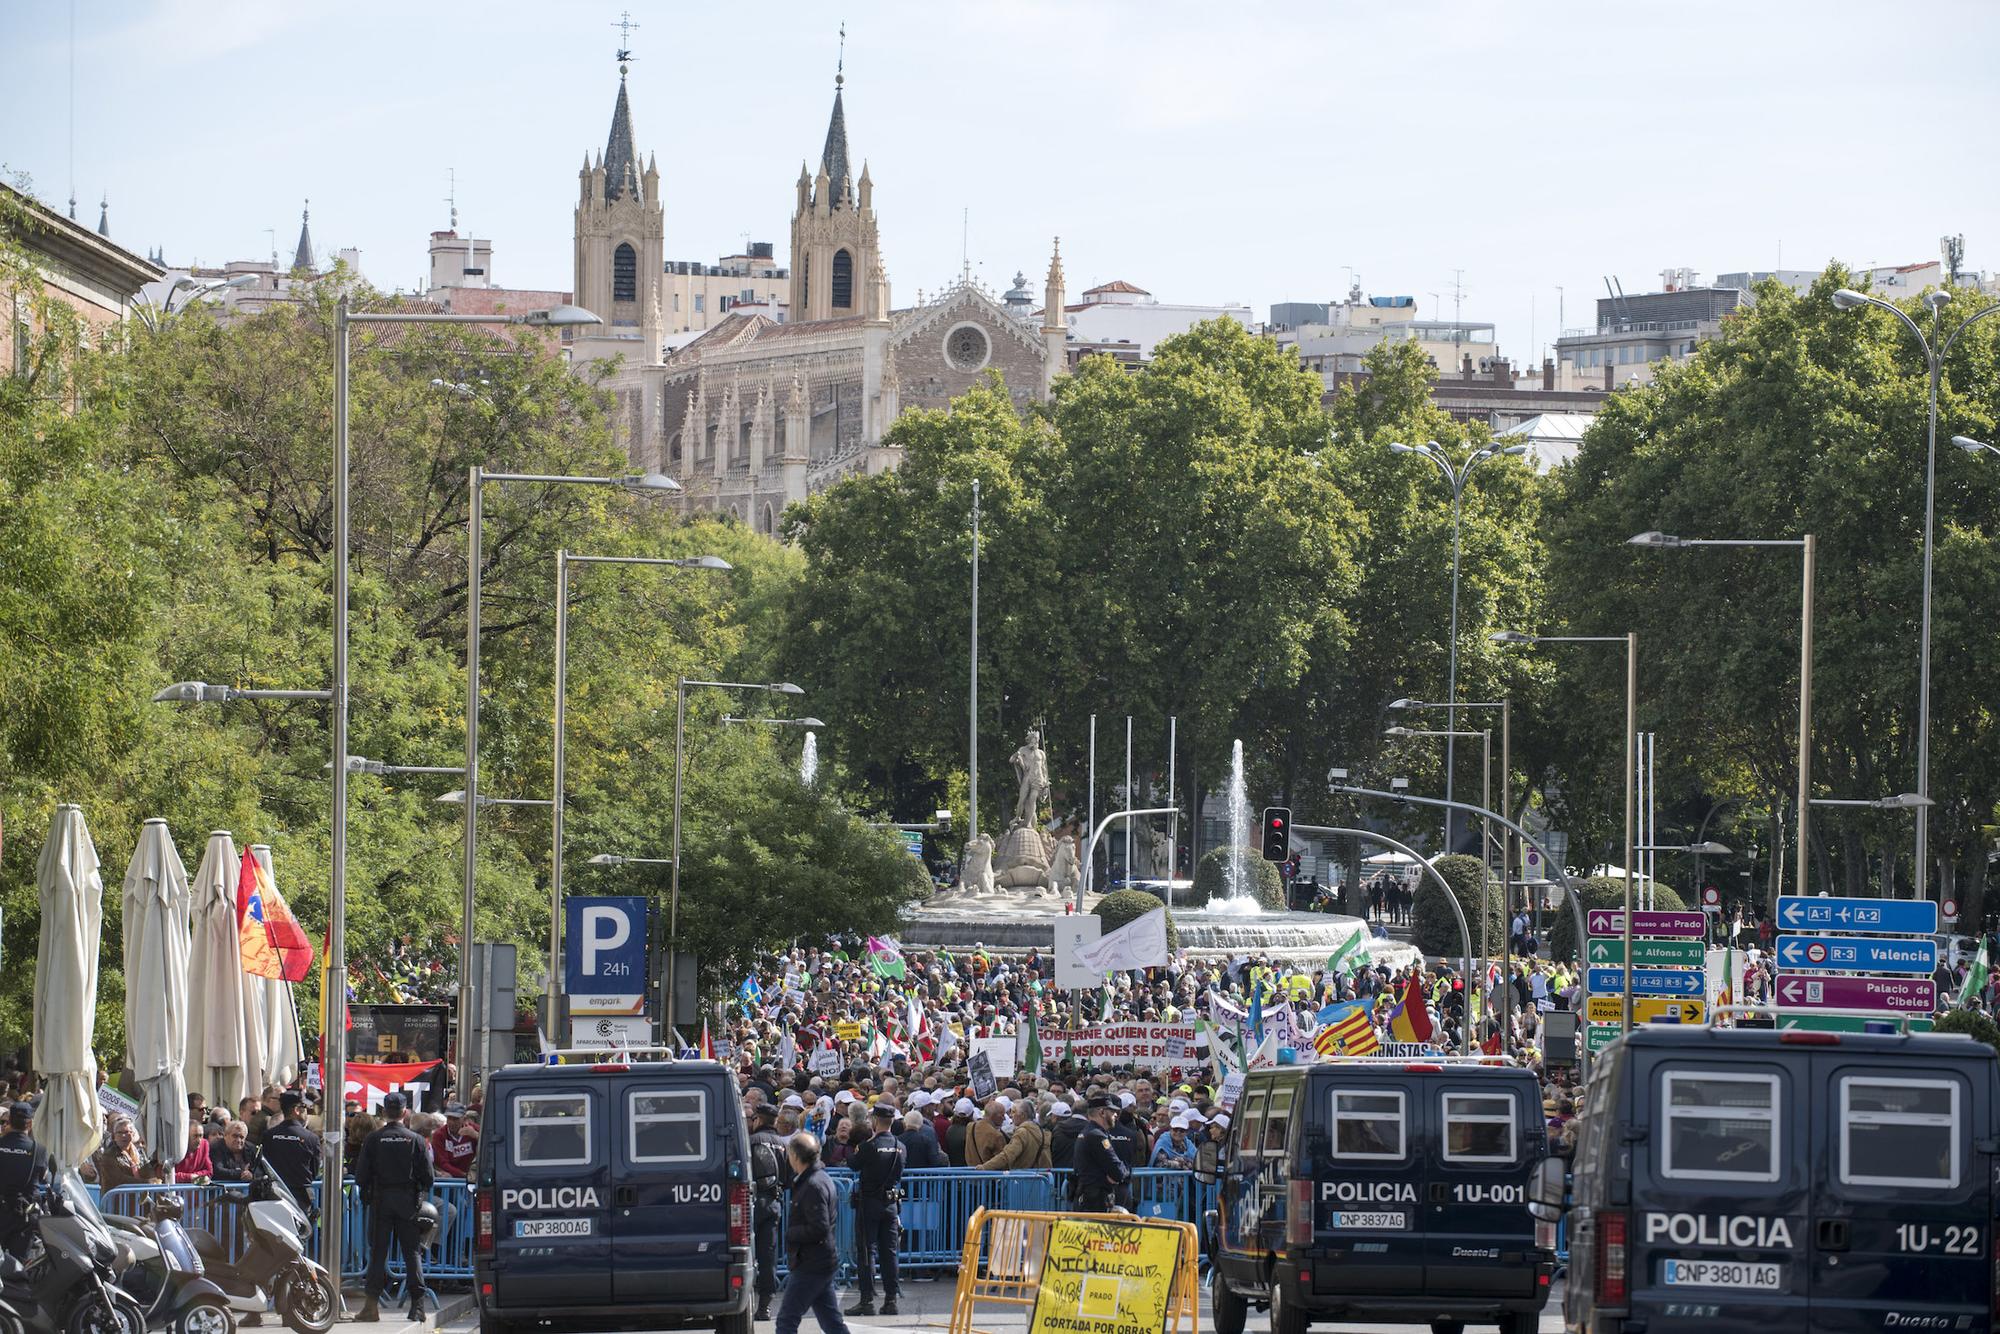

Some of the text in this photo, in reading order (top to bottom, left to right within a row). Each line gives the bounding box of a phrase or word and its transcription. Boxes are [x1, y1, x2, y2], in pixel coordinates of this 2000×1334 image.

[1811, 909, 1878, 921] A-1 A-2
[1674, 919, 1702, 929] Prado
[582, 905, 631, 976] P
[1646, 948, 1682, 957] Alfonso
[1688, 949, 1701, 958] XII
[1833, 948, 1931, 962] R-3 Valencia
[603, 963, 630, 976] 24h
[1602, 976, 1617, 984] A-3
[1642, 977, 1661, 986] A-42
[1666, 979, 1681, 987] R-5
[1867, 984, 1930, 995] Palacio de
[589, 998, 621, 1006] empark
[1886, 996, 1930, 1008] Cibeles
[1105, 1026, 1147, 1040] QUIEN
[1592, 1029, 1610, 1037] plaza
[1055, 1044, 1129, 1057] PNSIONES
[1133, 1045, 1148, 1057] SE
[345, 1081, 430, 1115] CNT
[502, 1184, 721, 1210] POLICIA 1U-20
[1322, 1182, 1524, 1202] POLICIA 1U-001
[1646, 1213, 1978, 1254] POLICIA 1U-22
[519, 1248, 554, 1256] FIAT
[1452, 1247, 1488, 1257] Ducato
[1089, 1291, 1113, 1301] PRADO
[1665, 1304, 1719, 1317] FIAT
[1044, 1316, 1152, 1334] CORTADA POR OBRAS
[1884, 1312, 1949, 1329] Ducato
